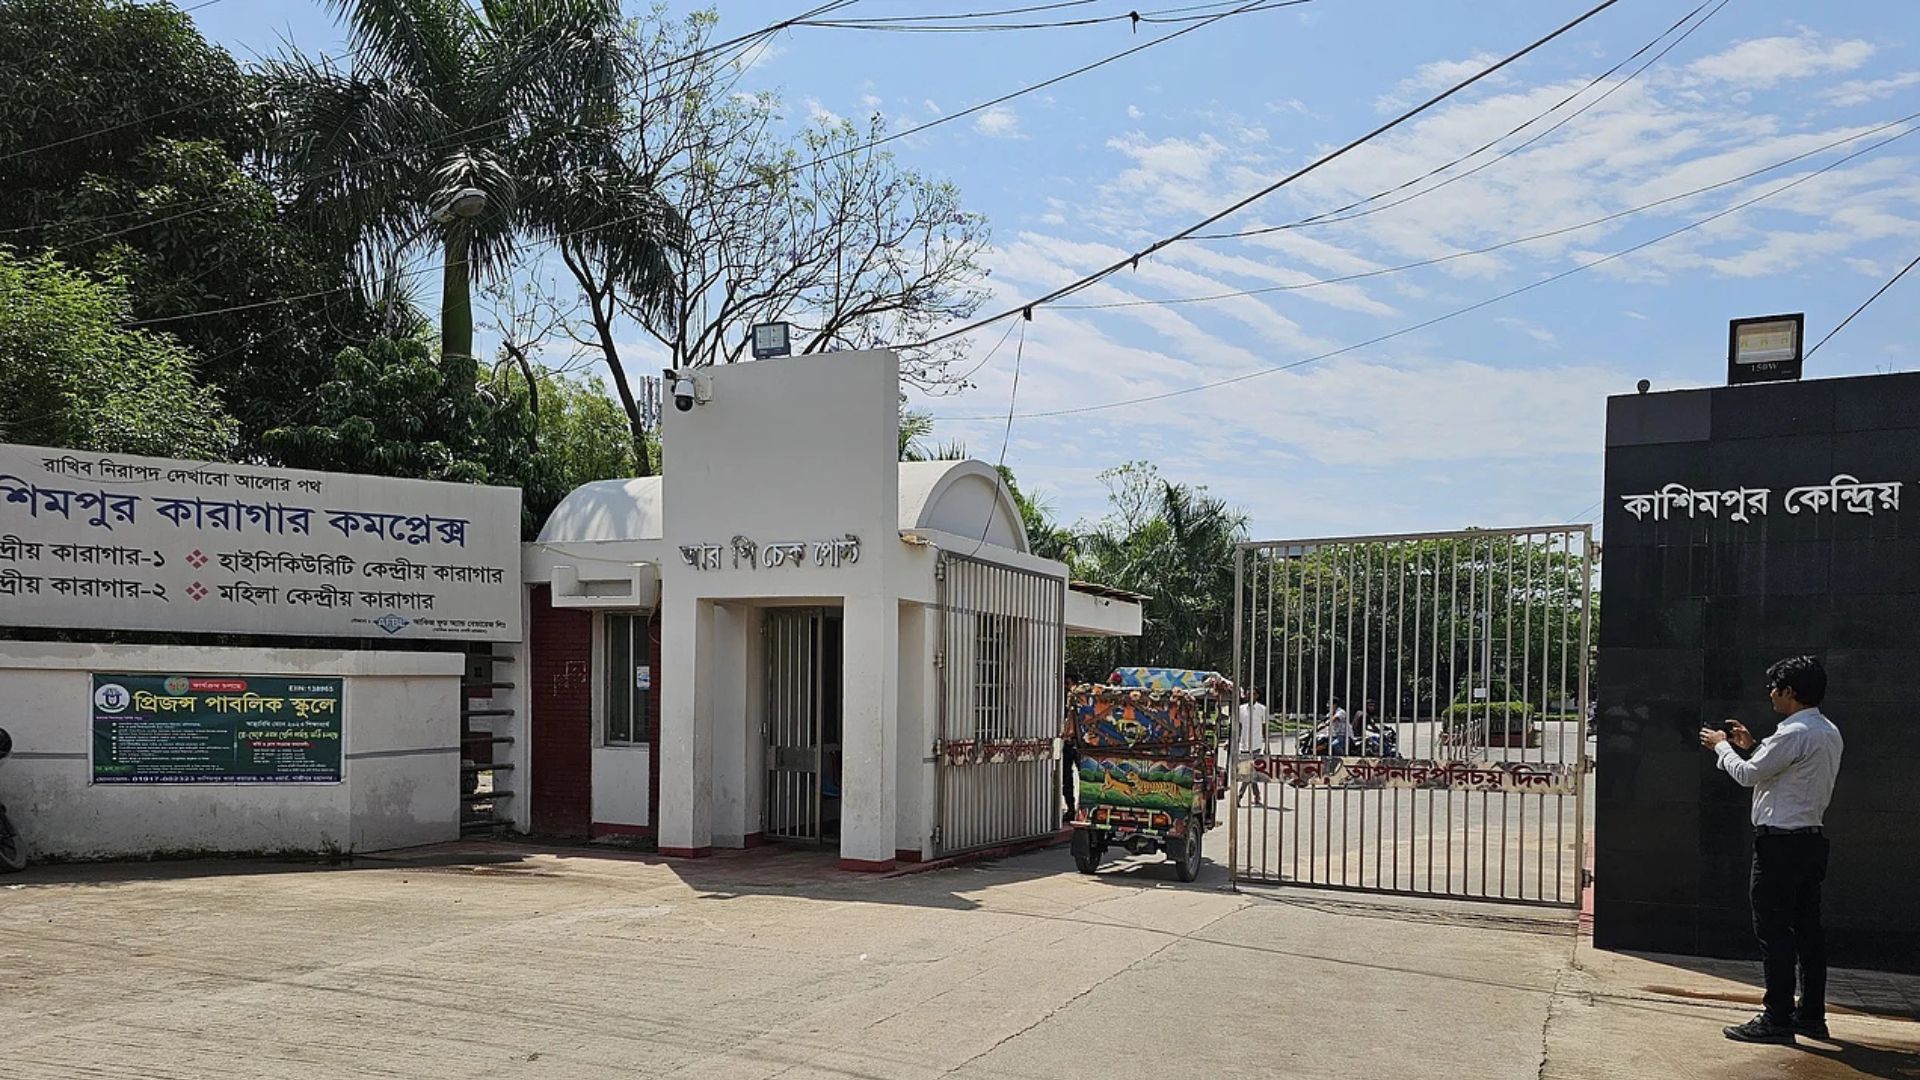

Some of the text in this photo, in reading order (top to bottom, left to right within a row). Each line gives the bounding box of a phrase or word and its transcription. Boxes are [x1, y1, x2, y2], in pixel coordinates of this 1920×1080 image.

[42, 455, 322, 494] রাখিব নিরাপদ দেখাবো আলোর পথ
[1620, 474, 1903, 523] কাশিমপুর কেন্দ্রিয়
[151, 496, 315, 536] কারাগার
[324, 510, 470, 548] কমপ্লেক্স
[48, 543, 165, 567] কারাগার-১
[217, 549, 505, 584] হাইসিকিউরিটি কেন্দ্রীয় কারাগার
[678, 542, 723, 570] আর
[730, 535, 758, 570] পি
[762, 541, 807, 568] চেক
[48, 576, 169, 602] কারাগার-২
[217, 581, 435, 610] মহিলা কেন্দ্রীয় কারাগার
[132, 690, 337, 719] প্রিজন্স পাবলিক স্কুলে
